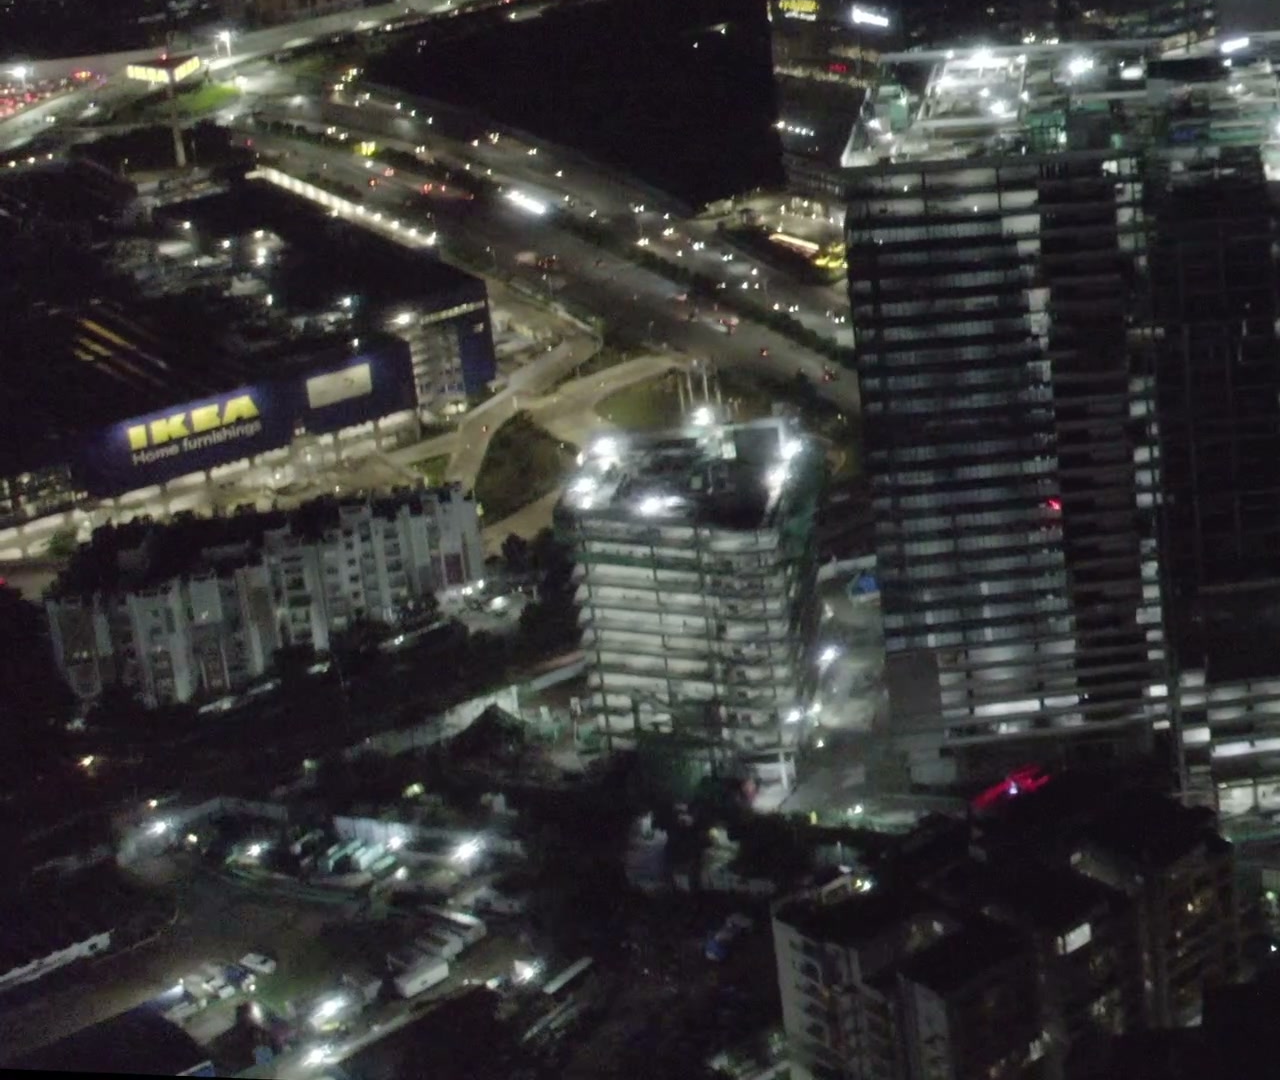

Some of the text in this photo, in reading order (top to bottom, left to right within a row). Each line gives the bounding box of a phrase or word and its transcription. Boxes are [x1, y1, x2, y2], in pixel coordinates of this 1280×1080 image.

[128, 394, 260, 451] IKEA
[132, 420, 263, 466] Home furnishings
